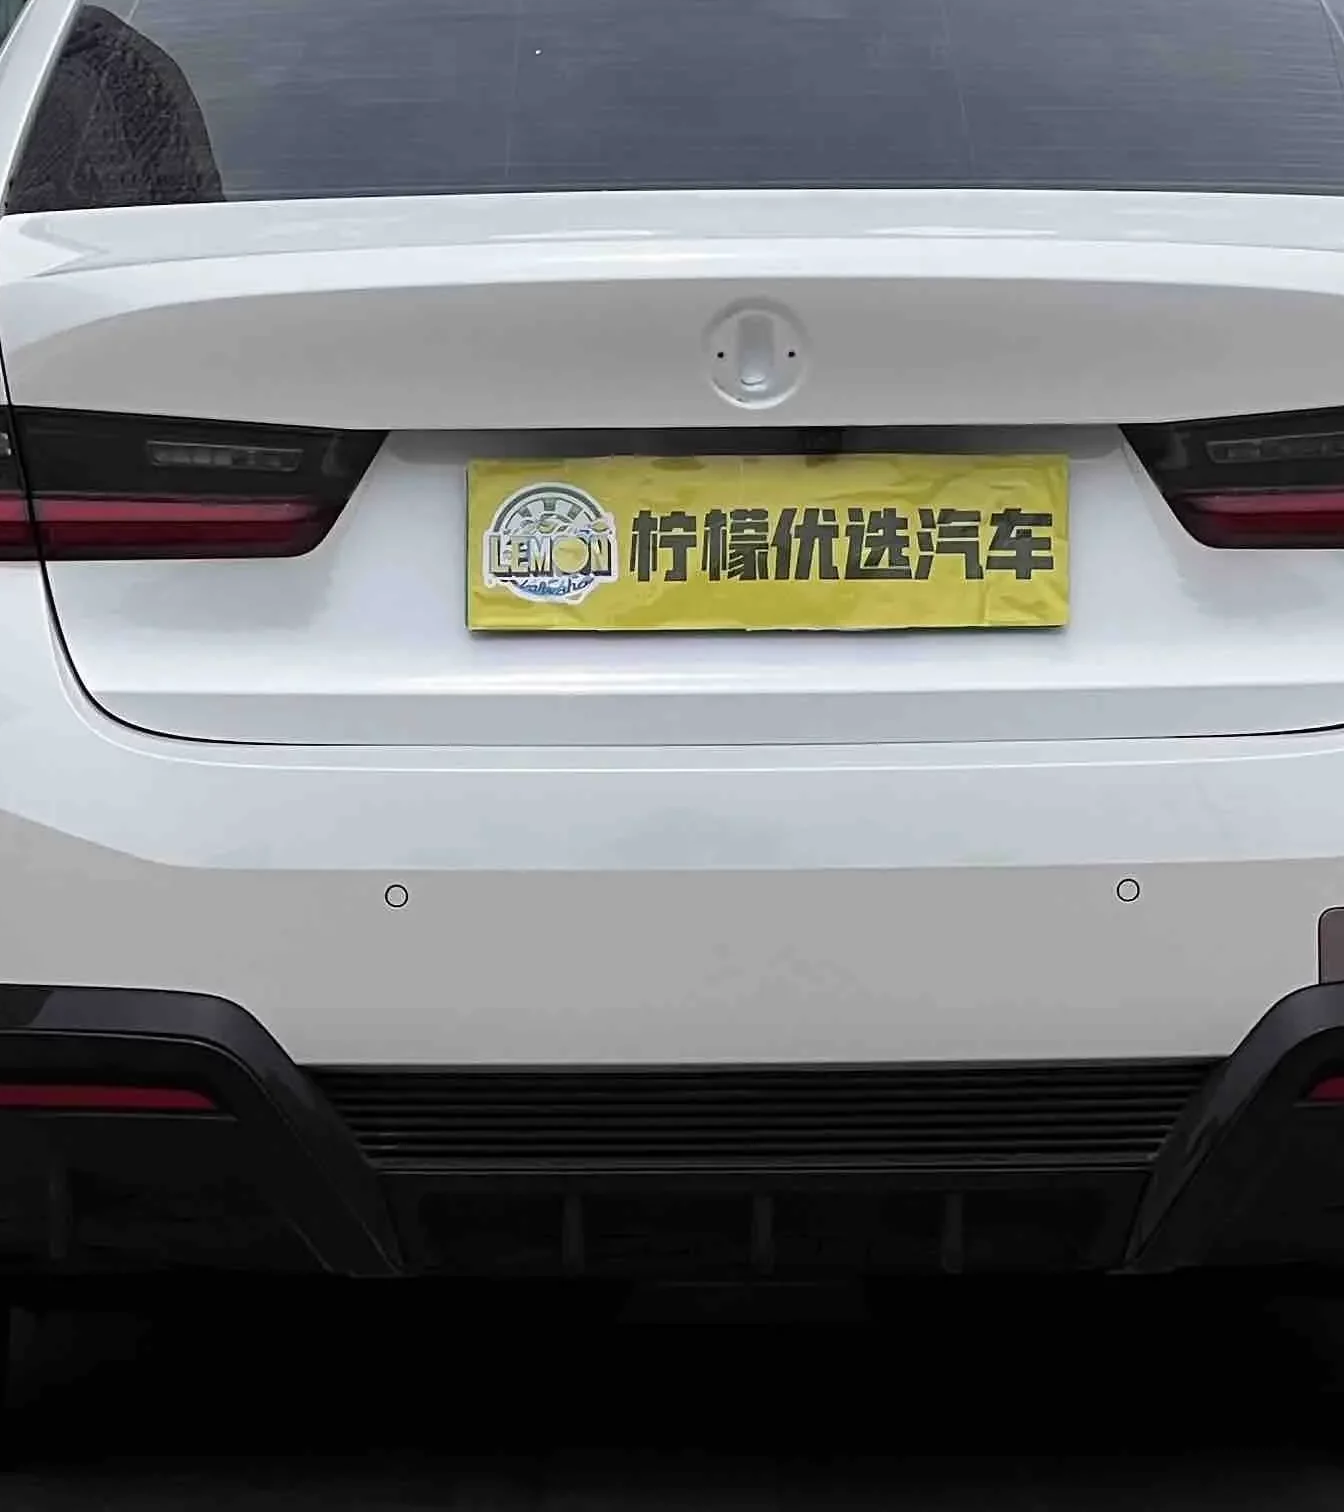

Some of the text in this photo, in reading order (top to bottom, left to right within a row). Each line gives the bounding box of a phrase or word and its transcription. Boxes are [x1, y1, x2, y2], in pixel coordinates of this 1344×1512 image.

[489, 530, 612, 577] LEMON
[630, 506, 1054, 583] 柠檬优选汽车
